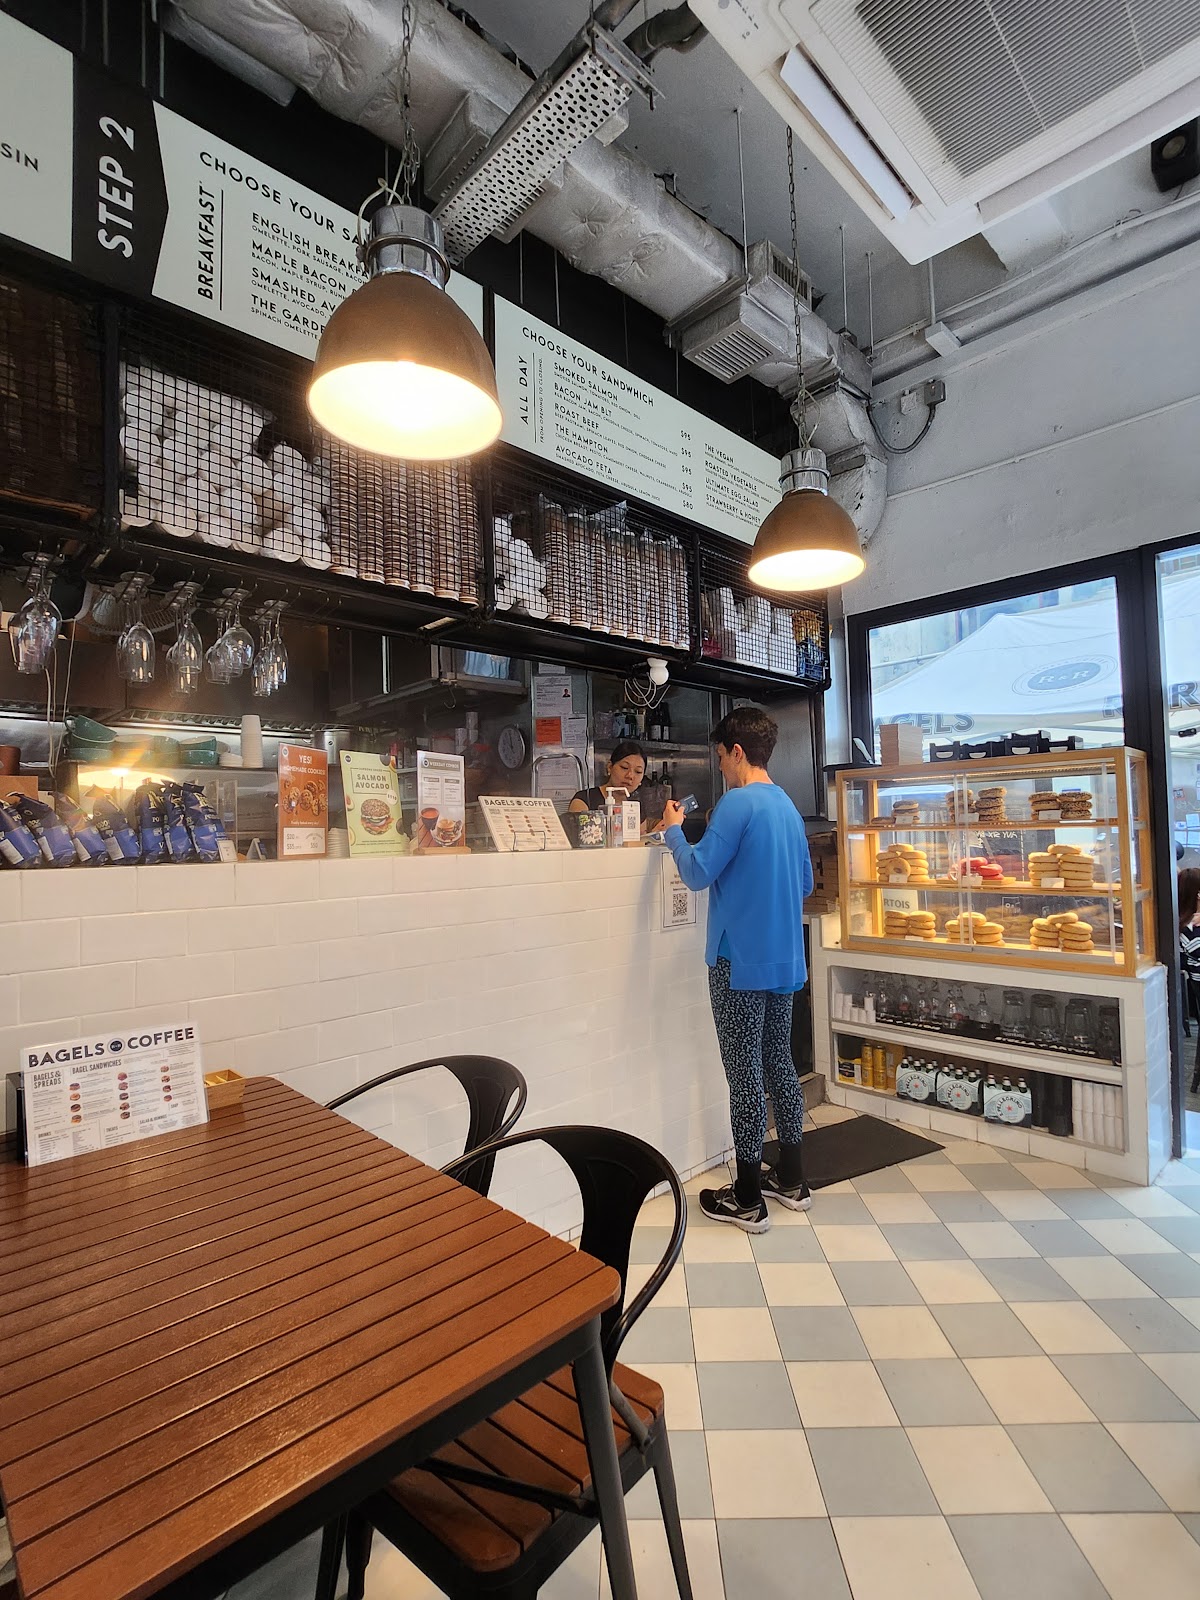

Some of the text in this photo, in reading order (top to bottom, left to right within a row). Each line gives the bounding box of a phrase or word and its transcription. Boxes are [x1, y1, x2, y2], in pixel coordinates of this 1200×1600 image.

[98, 116, 134, 258] STEP 2
[200, 152, 280, 204] CHOOSE
[289, 198, 335, 234] YOUR
[198, 185, 214, 300] BREAKFAST
[252, 212, 310, 250] ENGLISH
[252, 240, 346, 292] MAPLE BACON
[292, 245, 310, 258] PORK
[252, 252, 278, 270] BACON,
[282, 266, 303, 280] MAPLE
[306, 278, 328, 294] SYRUP,
[252, 267, 316, 304] SMASHED
[250, 307, 282, 324] SPINACH
[251, 294, 276, 314] THE
[292, 298, 327, 318] AVOCADO,
[522, 327, 654, 407] CHOOSE YOUR SANDWHICH
[554, 362, 618, 401] SMOKED SALMON
[518, 355, 529, 426] ALL DAY
[554, 382, 612, 417] BACON JAM BLT
[554, 402, 599, 430] ROAST BEEF
[555, 422, 608, 453] THE HAMPTON
[680, 430, 691, 441] $95
[556, 445, 612, 475] AVOCADO FETA
[681, 447, 692, 458] $95
[704, 443, 734, 463] THE VEGAN
[682, 465, 692, 475] $95
[705, 460, 728, 477] ROASTED
[730, 472, 757, 492] VEGETABLE
[682, 482, 692, 492] $95
[706, 477, 729, 494] ULTIMATE
[731, 490, 741, 499] EGG
[743, 495, 759, 508] SALAD
[706, 494, 739, 514] STRAWBERRY
[745, 512, 761, 523] HONEY
[1039, 676, 1055, 684] R
[1072, 670, 1089, 680] R
[299, 755, 312, 764] YES!
[28, 1043, 105, 1068] BAGELS
[127, 1027, 195, 1049] COFFEE
[33, 1072, 54, 1081] BAGELS
[72, 1059, 122, 1075] BAGEL SANDWICHES
[34, 1078, 62, 1089] SPREADS
